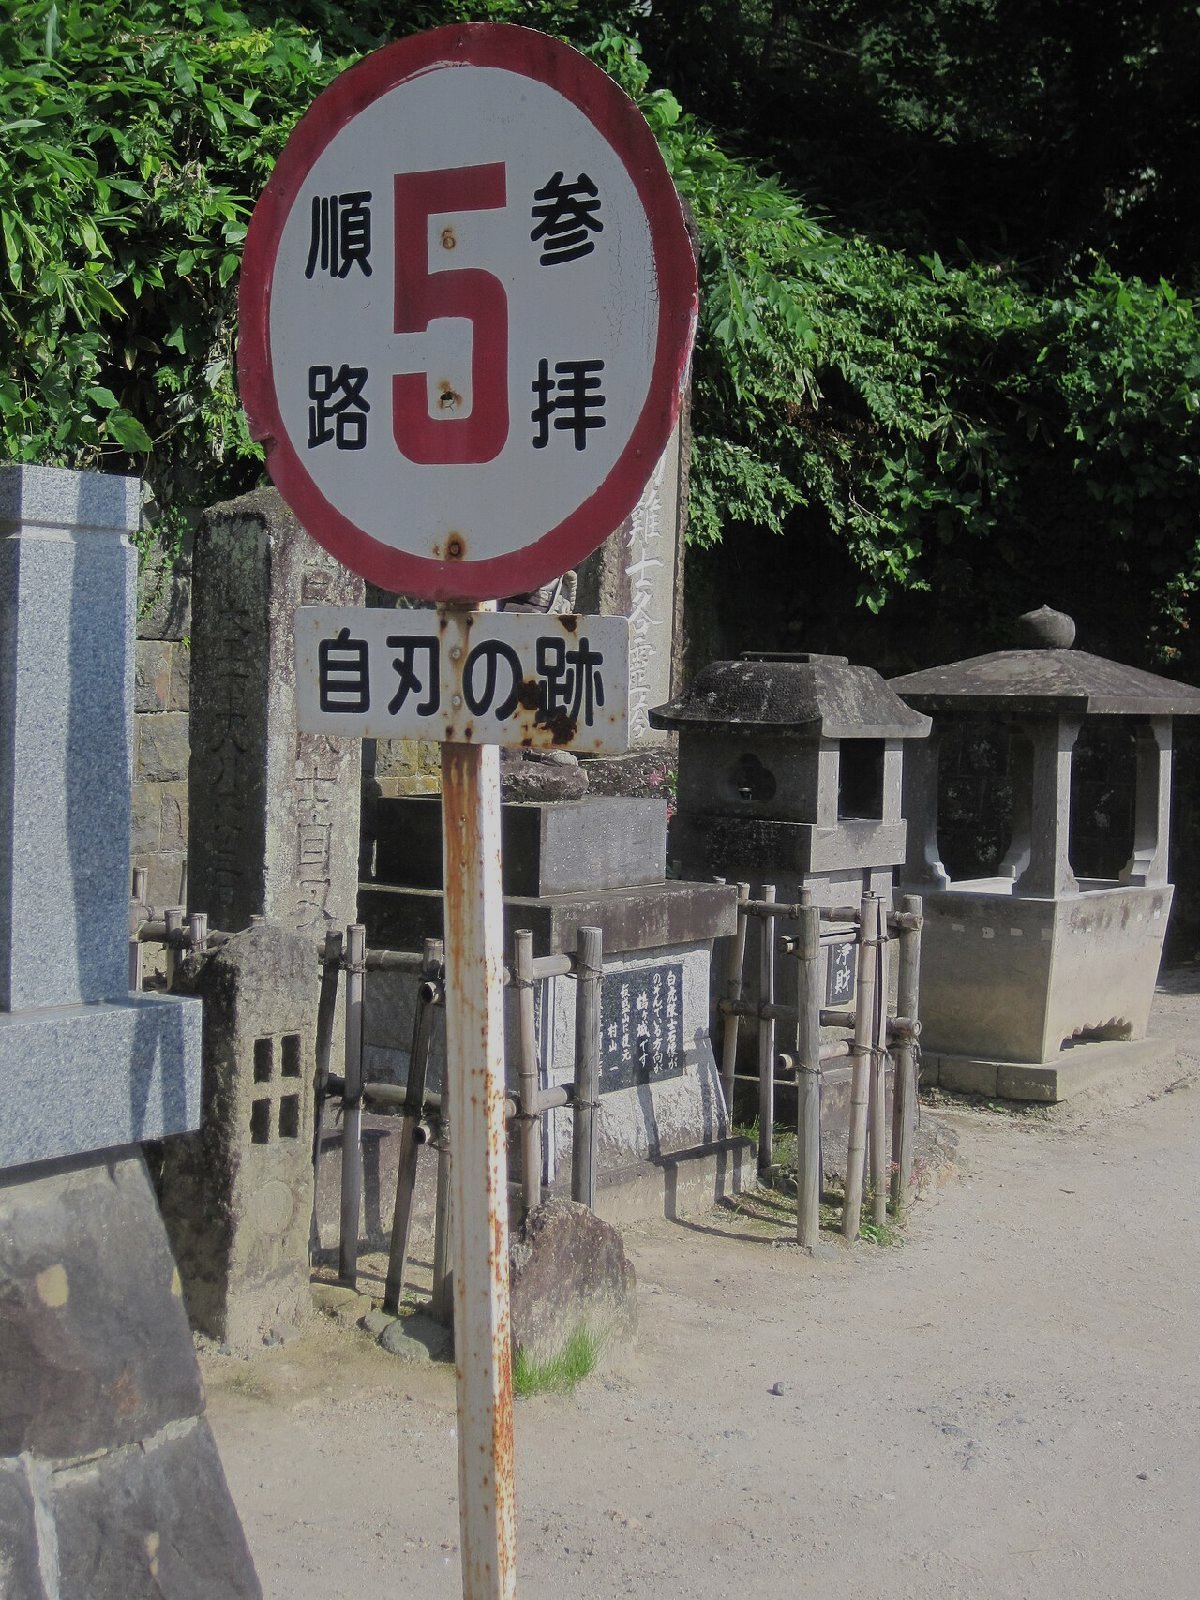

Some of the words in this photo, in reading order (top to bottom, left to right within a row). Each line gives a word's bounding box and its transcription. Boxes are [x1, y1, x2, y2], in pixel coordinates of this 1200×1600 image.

[305, 190, 372, 450] 順路
[392, 161, 510, 465] 5
[530, 171, 606, 451] 参拝
[318, 627, 605, 727] 自刃の跡
